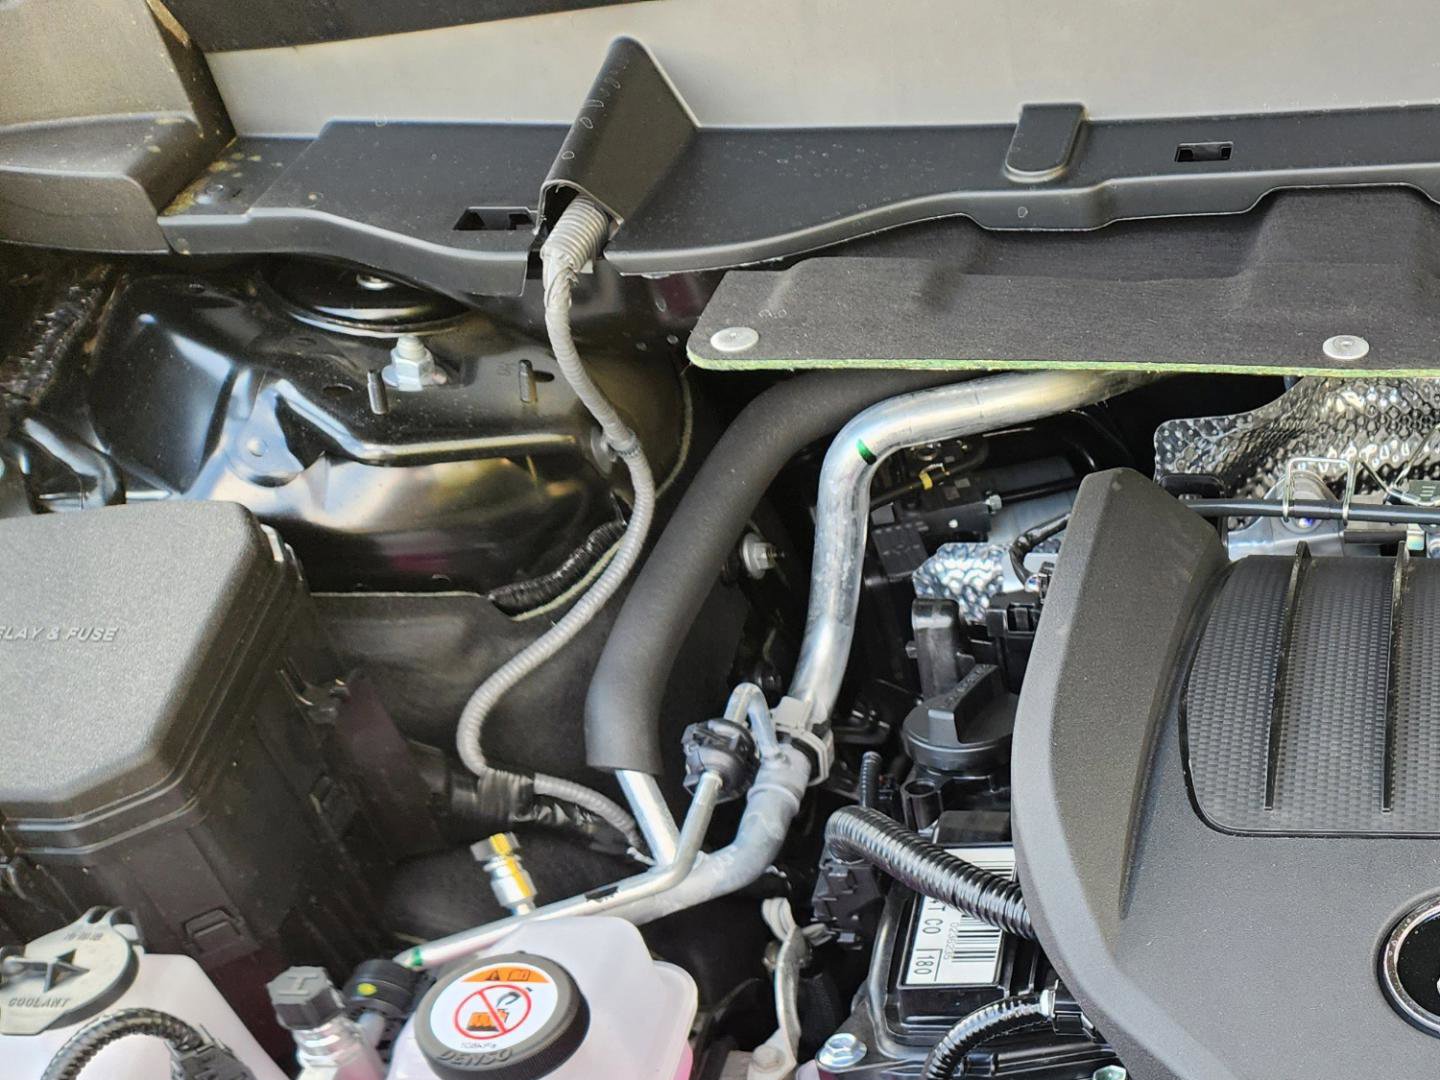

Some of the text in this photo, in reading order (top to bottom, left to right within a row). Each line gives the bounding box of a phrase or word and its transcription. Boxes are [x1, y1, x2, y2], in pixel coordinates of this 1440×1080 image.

[46, 626, 60, 641] &
[66, 626, 119, 642] FUSE
[913, 954, 934, 975] 180
[8, 997, 71, 1008] COOLANT
[435, 1049, 513, 1067] DENSO
